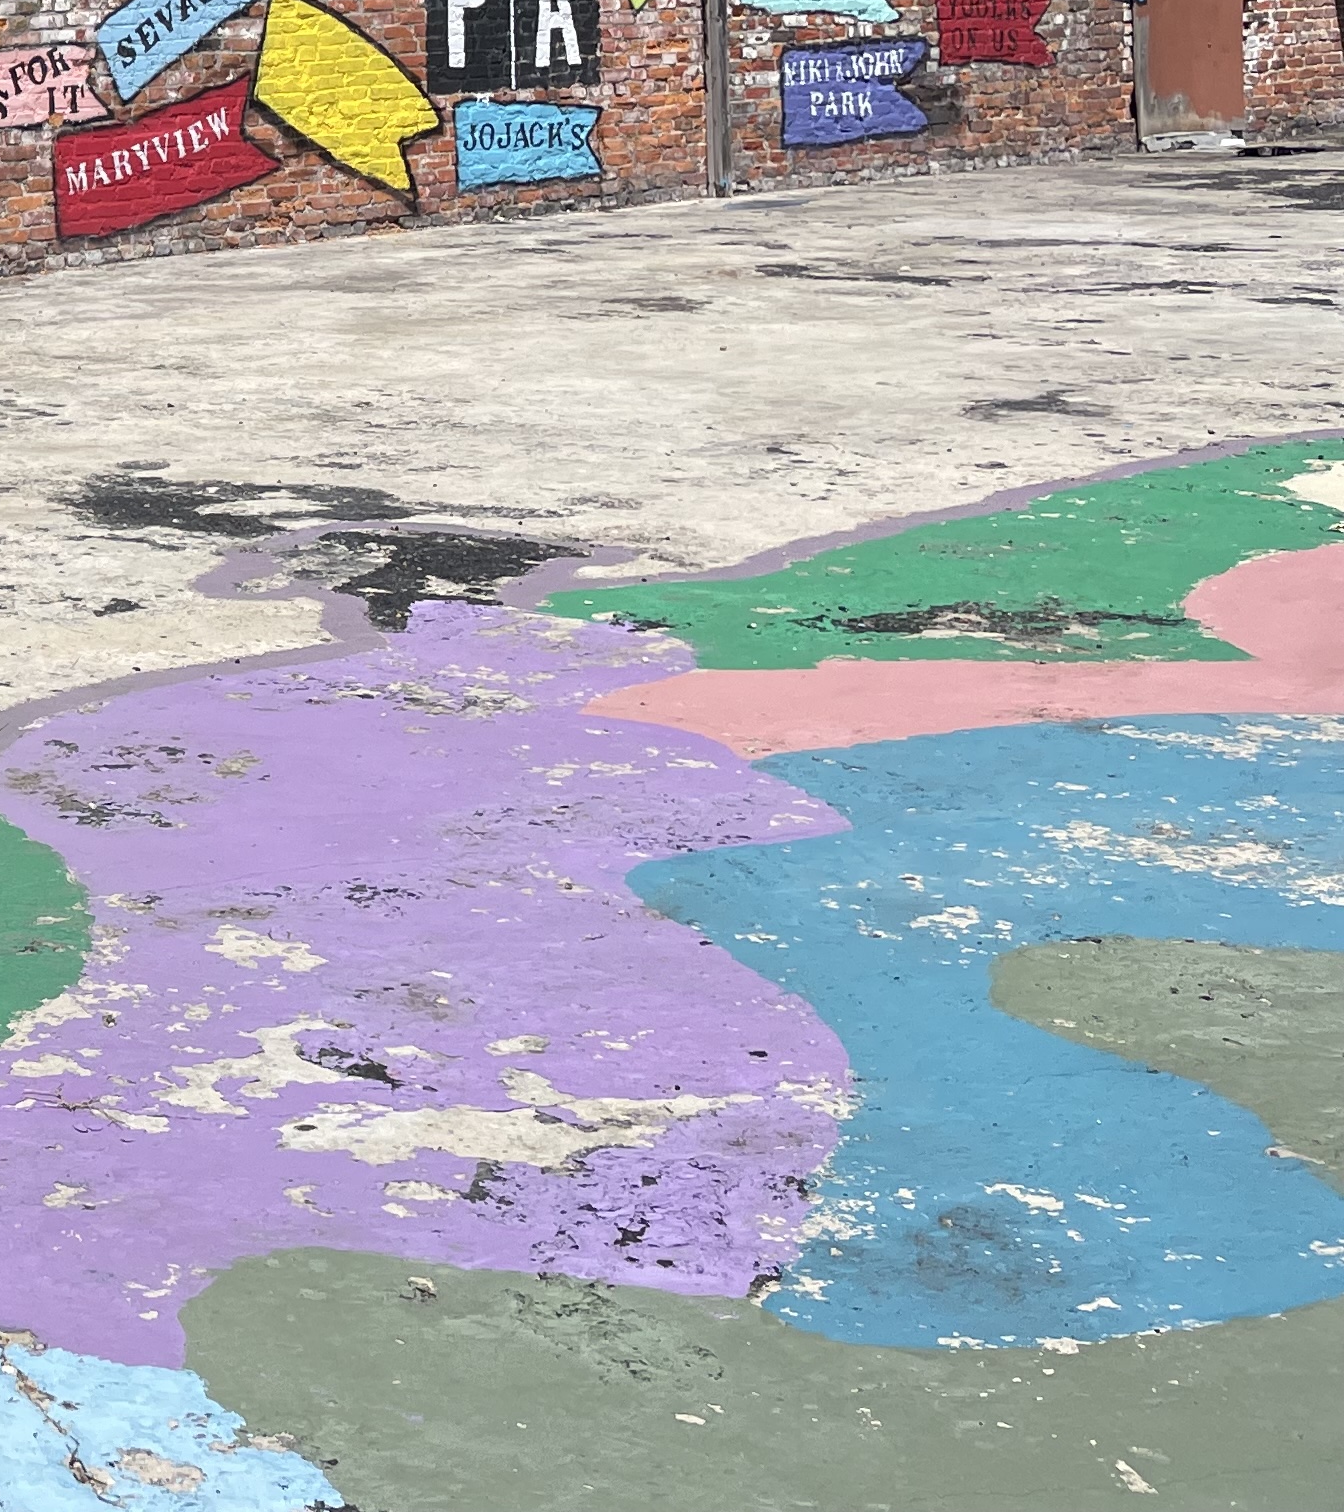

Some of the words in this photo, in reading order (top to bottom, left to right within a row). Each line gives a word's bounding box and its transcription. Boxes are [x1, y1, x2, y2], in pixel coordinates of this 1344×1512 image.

[8, 46, 71, 97] FOR
[809, 90, 874, 118] PARK
[64, 106, 233, 195] MARYVIEW
[462, 118, 588, 152] JOJACK'S
